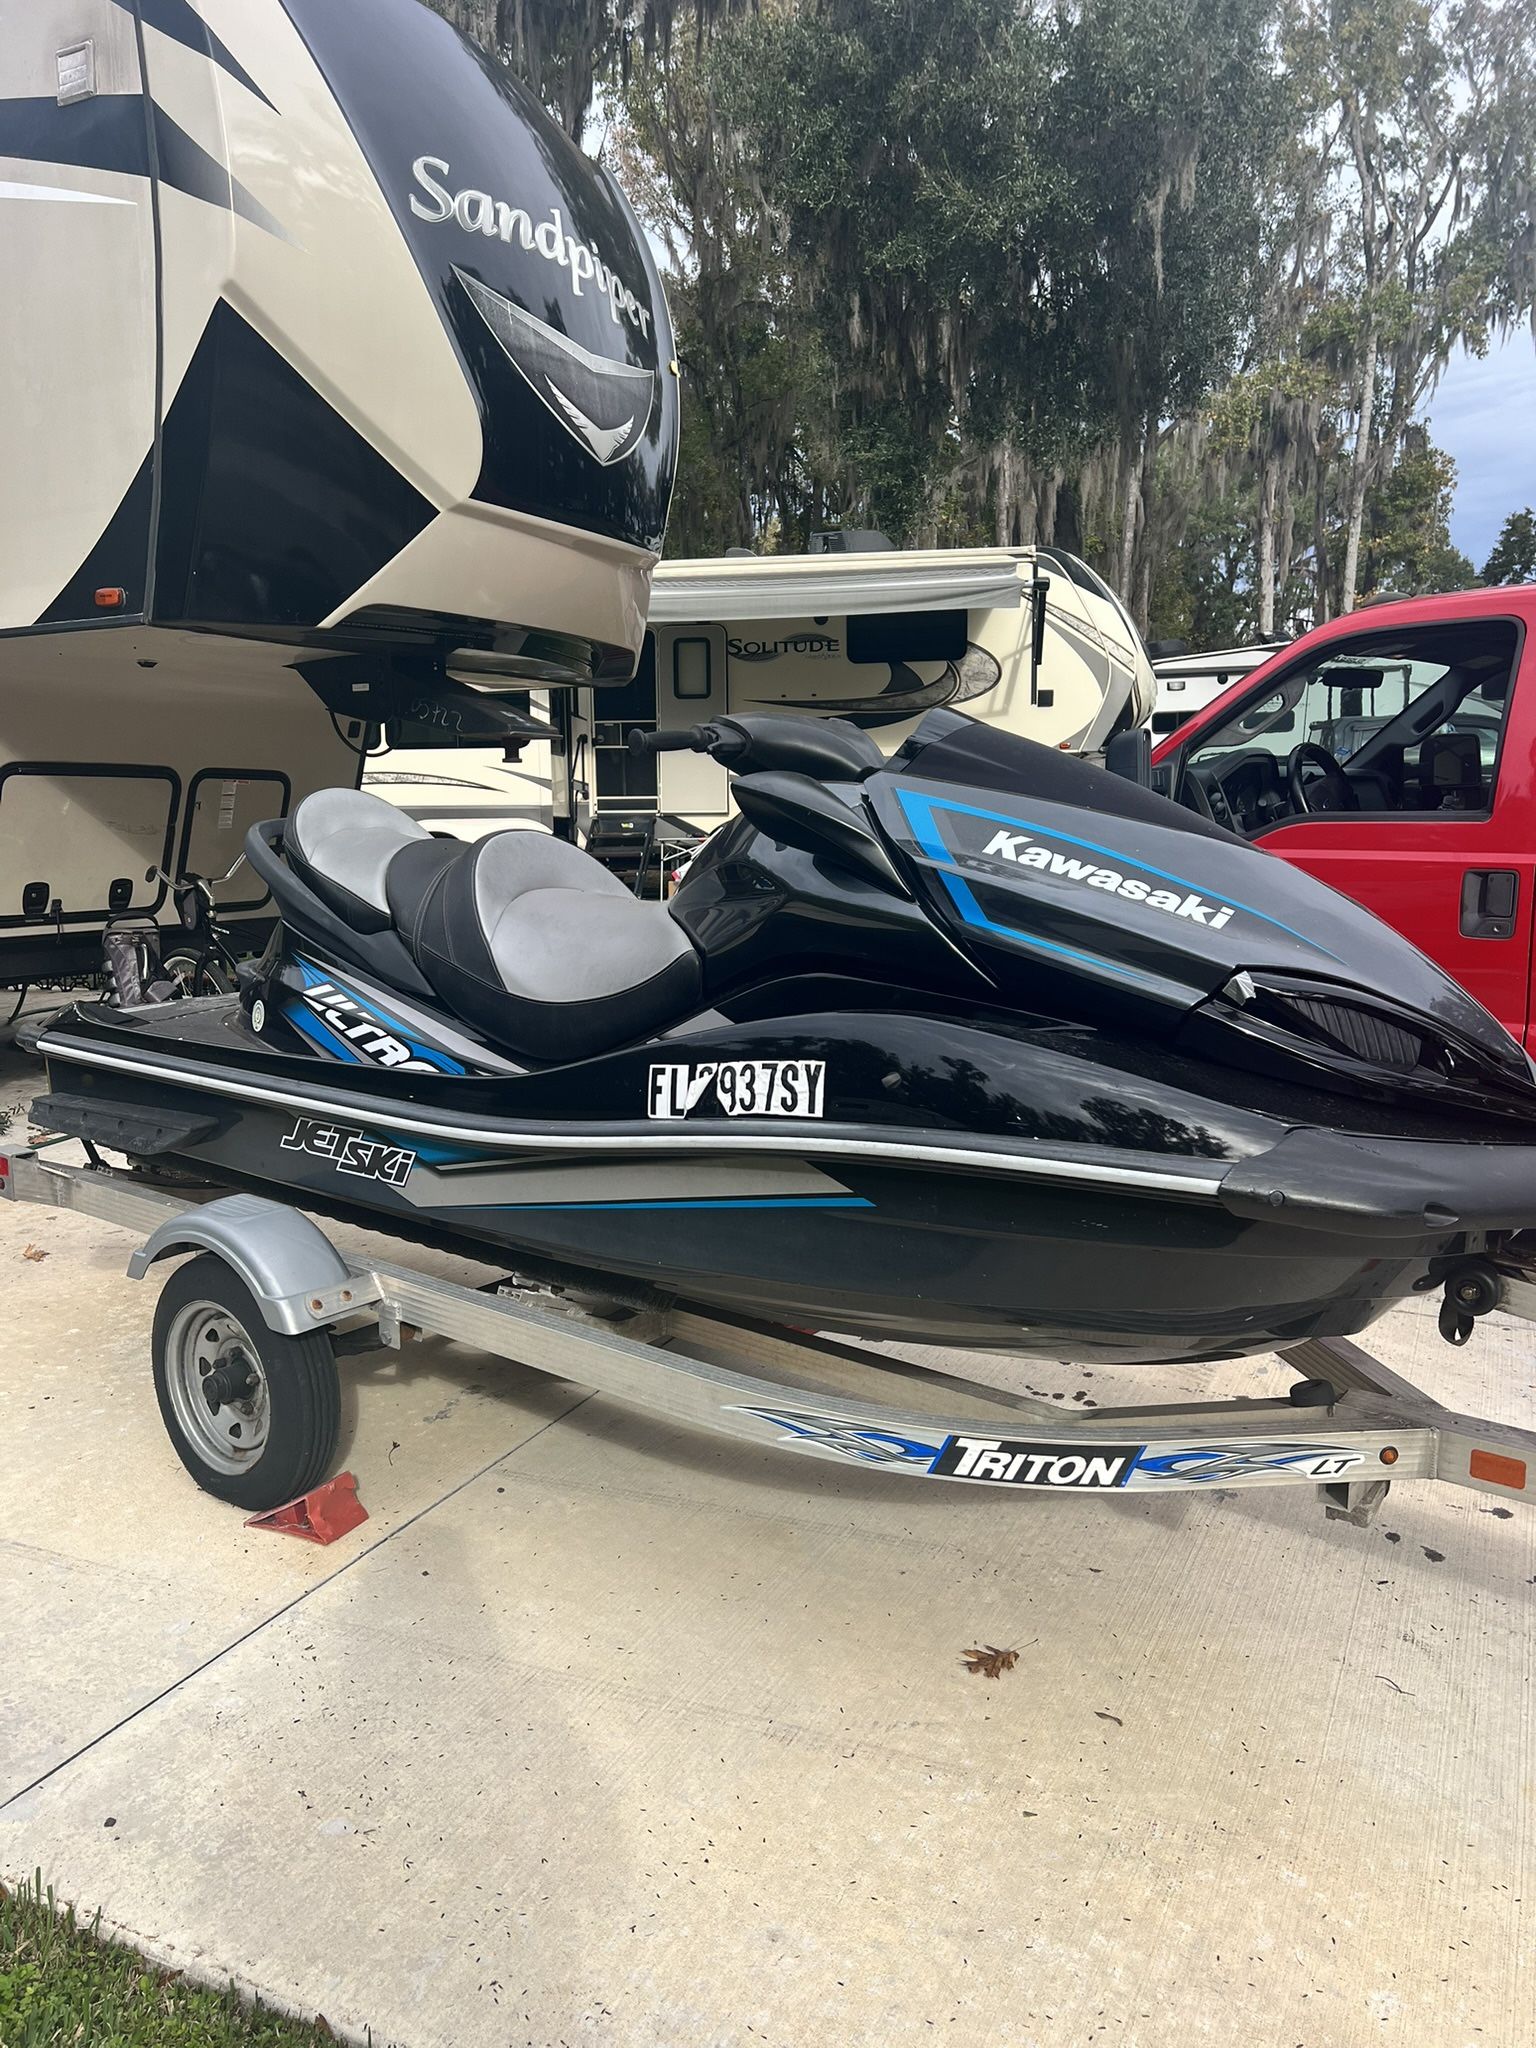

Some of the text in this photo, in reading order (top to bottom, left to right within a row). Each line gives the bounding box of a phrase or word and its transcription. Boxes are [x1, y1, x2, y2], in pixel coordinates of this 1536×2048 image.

[409, 155, 651, 340] Sandpiper
[728, 638, 840, 655] SOLITUDE
[982, 829, 1236, 930] Kawasaki
[699, 1063, 823, 1115] 937SY
[952, 1437, 1126, 1486] TRITON
[1310, 1458, 1361, 1475] LT
